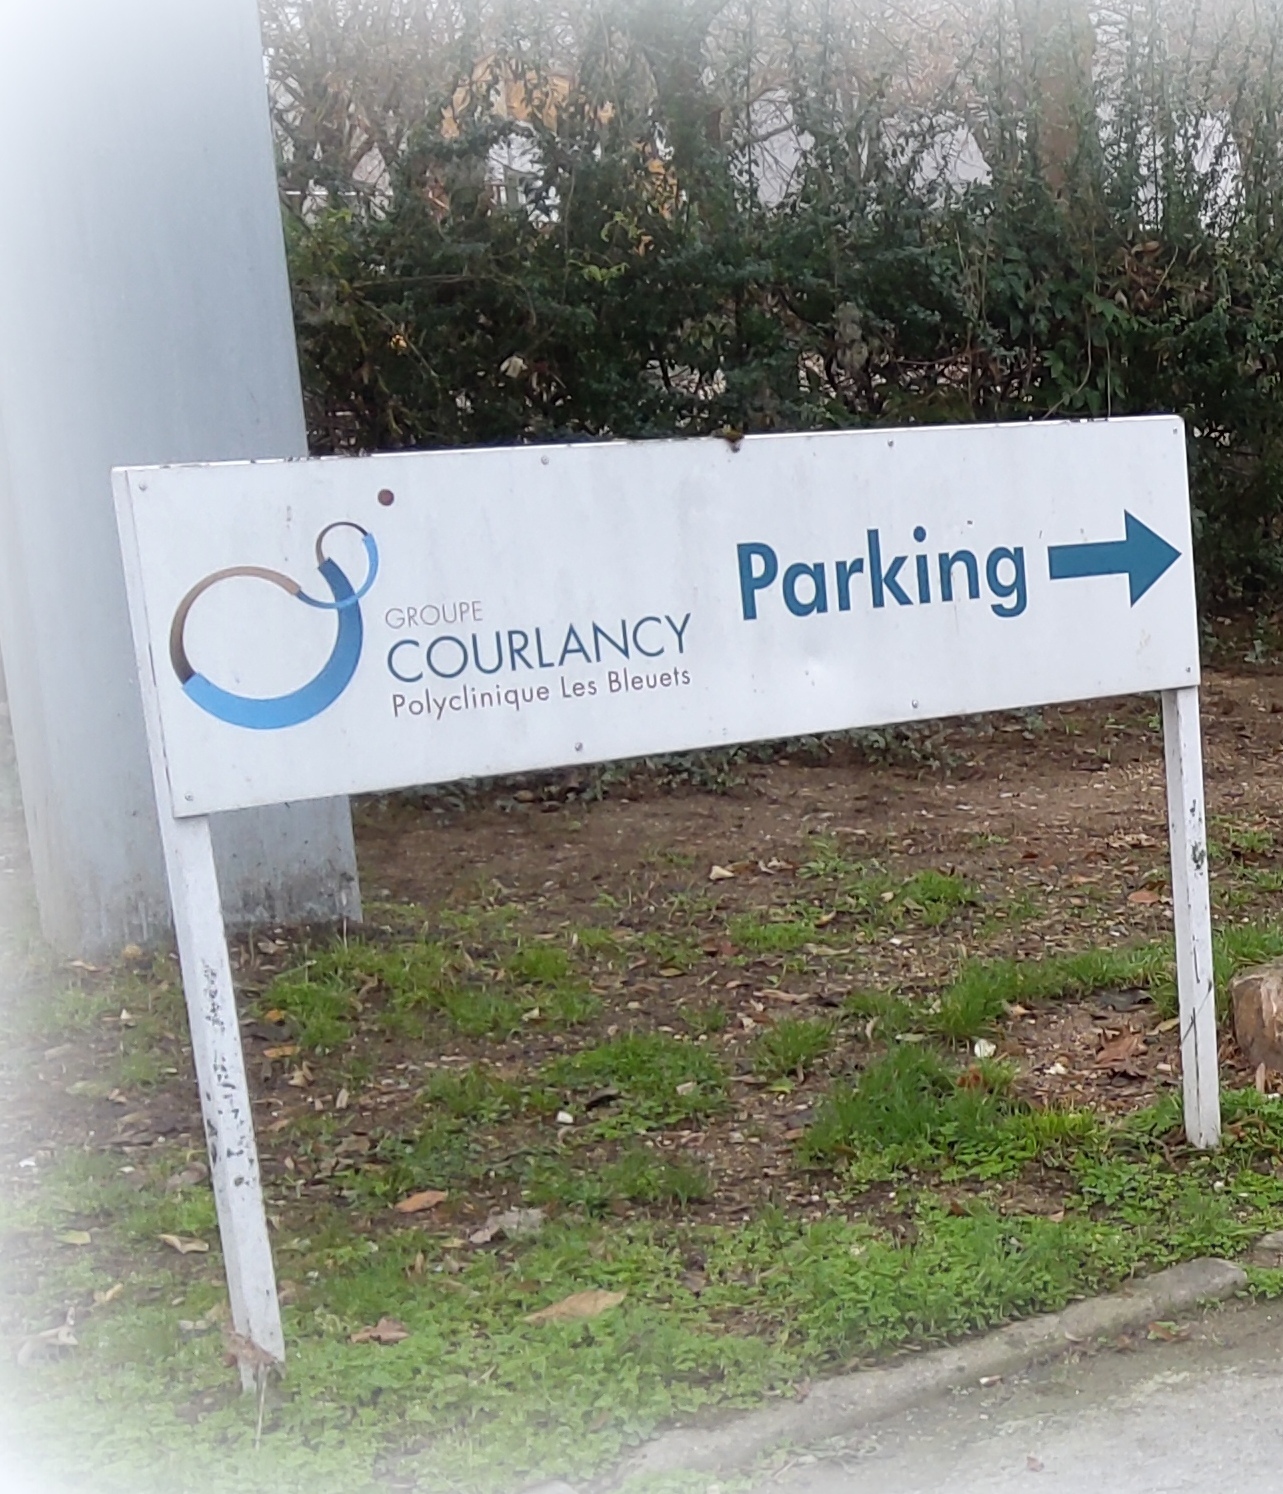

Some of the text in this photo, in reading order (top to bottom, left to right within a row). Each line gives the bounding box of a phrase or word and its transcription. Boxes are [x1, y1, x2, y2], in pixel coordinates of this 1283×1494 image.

[736, 525, 1028, 621] Parking
[385, 600, 483, 629] GROUPE
[387, 612, 691, 683] COURLANCY
[392, 667, 692, 721] Polyclinique Les Bleuets
